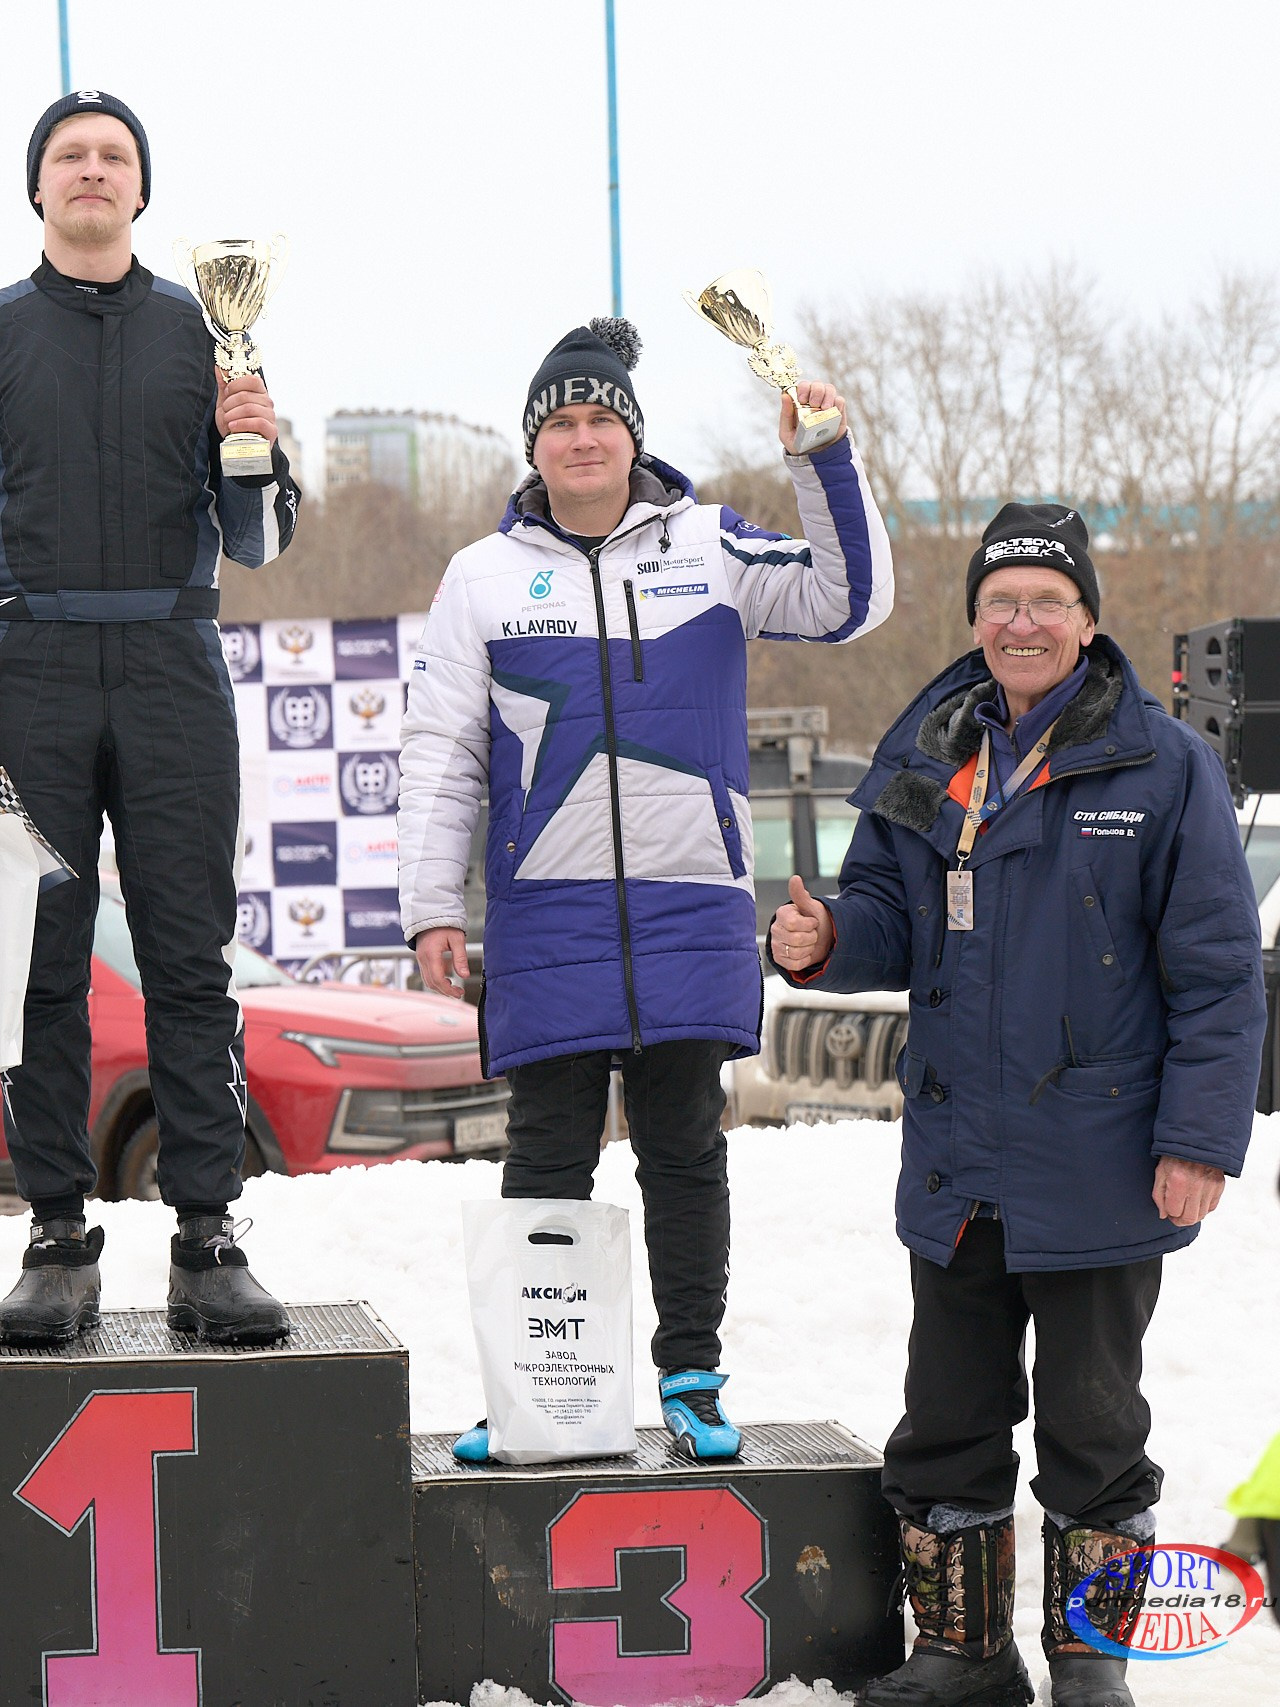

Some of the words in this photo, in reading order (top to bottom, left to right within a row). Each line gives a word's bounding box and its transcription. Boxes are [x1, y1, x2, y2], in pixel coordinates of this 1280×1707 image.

[637, 561, 660, 575] SQD
[657, 585, 706, 595] MICHELIN
[521, 601, 567, 613] PETRONAS
[502, 619, 578, 637] K.LAVROV
[1073, 811, 1097, 821] СТК
[1097, 811, 1146, 823] СИБАДИ
[1126, 828, 1136, 838] В.
[521, 1283, 587, 1304] АКСИОН
[528, 1317, 585, 1340] ЗМТ
[545, 1350, 577, 1361] ЗАВОД
[514, 1362, 615, 1374] МИКРОЭЛЕКТРОННЫХ
[532, 1375, 597, 1386] ТЕХНОЛОГИЙ
[13, 1386, 202, 1707] 1
[545, 1483, 770, 1707] 3
